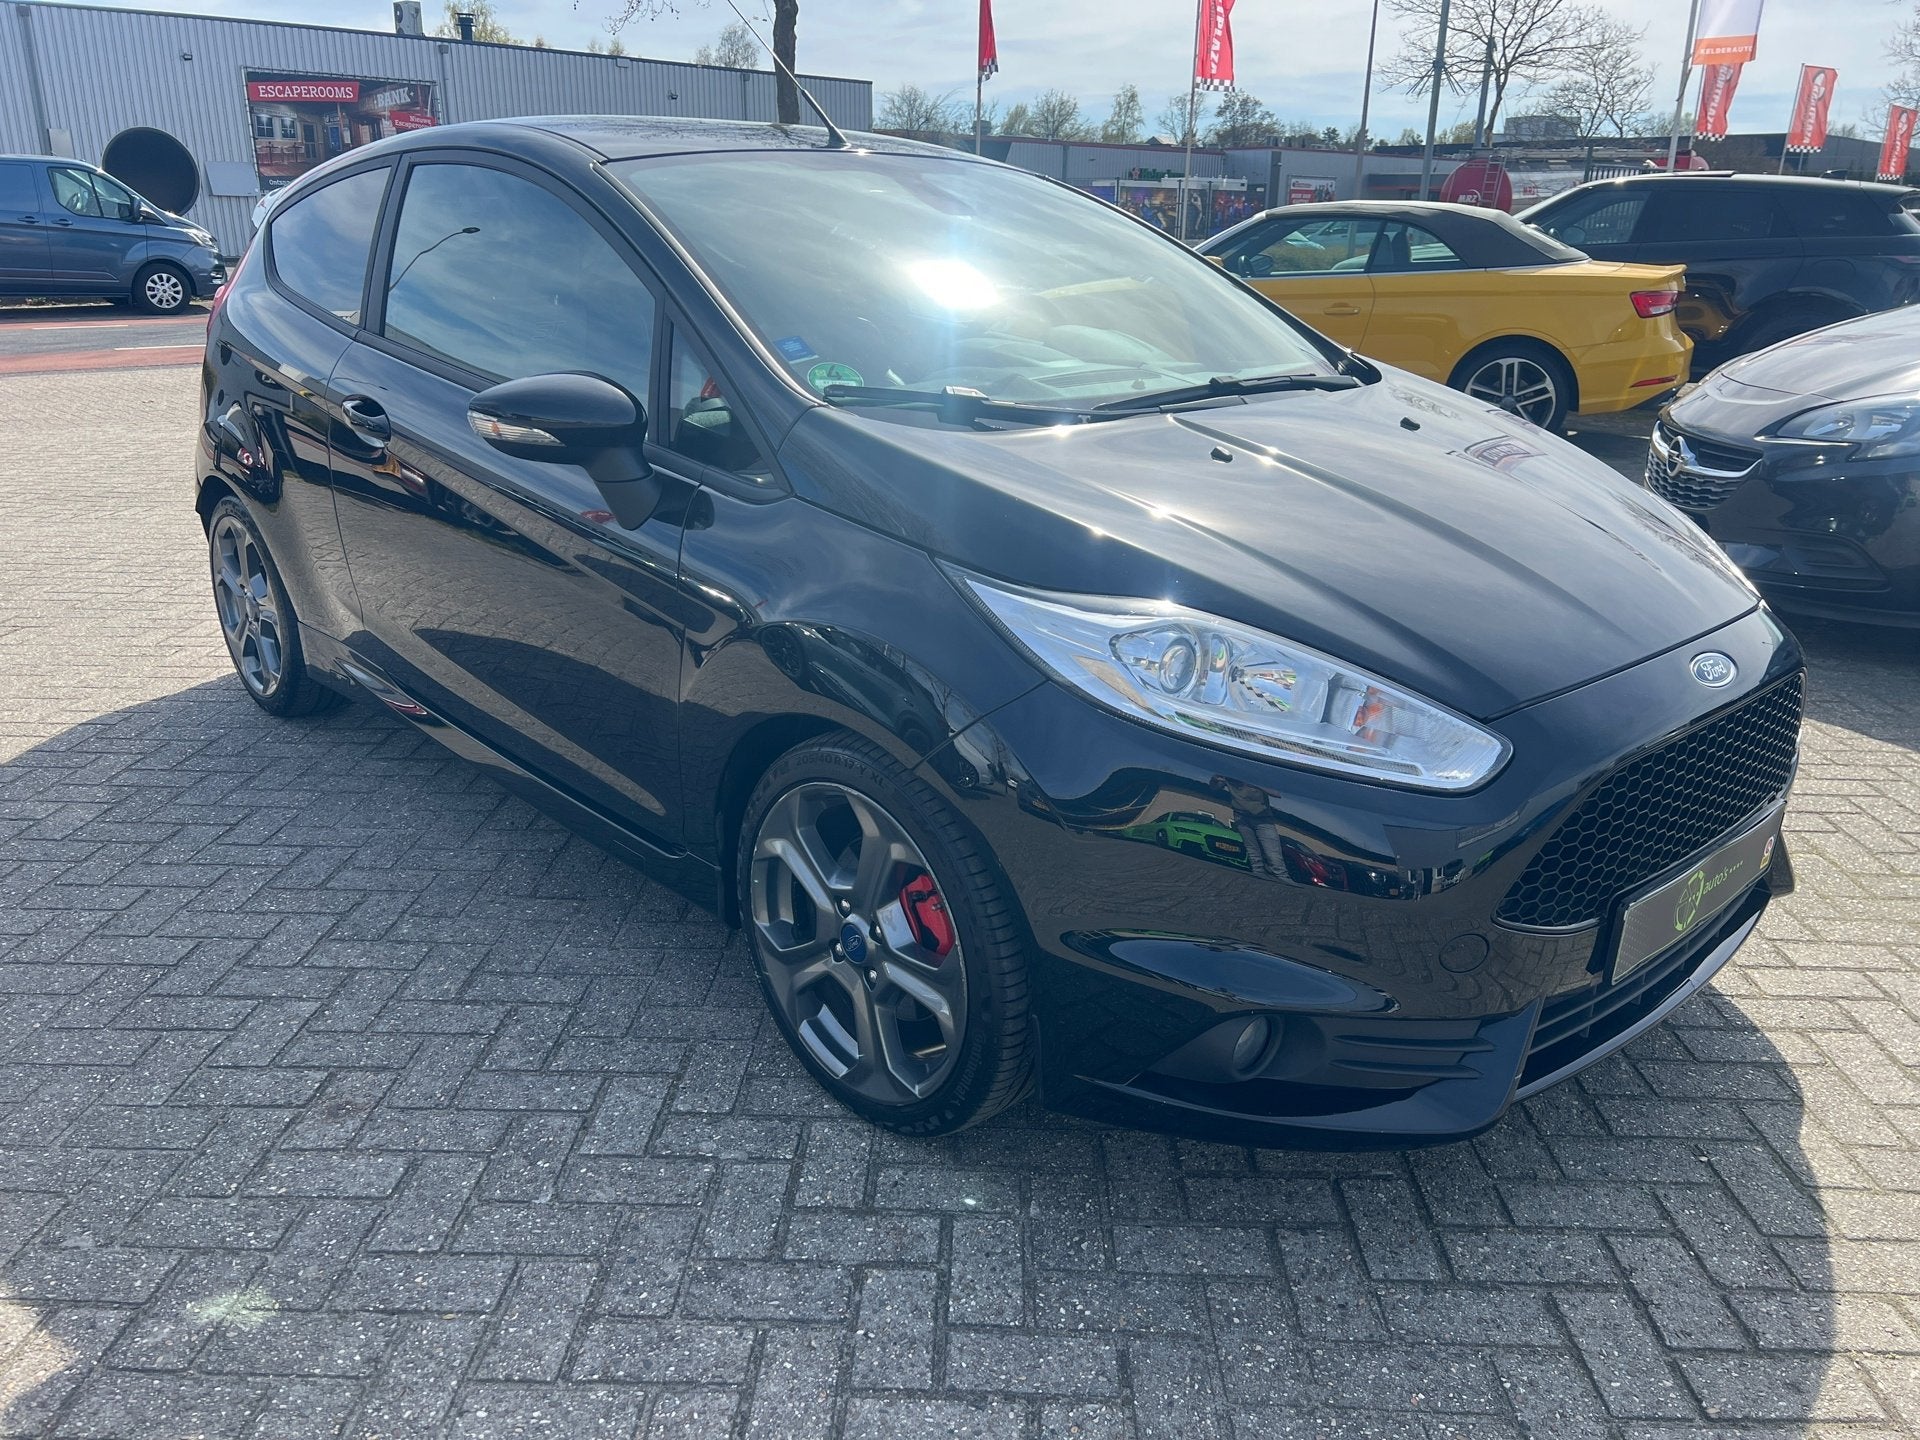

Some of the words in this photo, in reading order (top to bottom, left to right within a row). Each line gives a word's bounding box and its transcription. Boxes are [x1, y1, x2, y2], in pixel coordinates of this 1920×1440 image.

[1210, 0, 1225, 74] TPLAZA
[258, 85, 354, 99] ESCAPEROOMS
[377, 87, 411, 107] BANK
[1700, 659, 1727, 681] Ford
